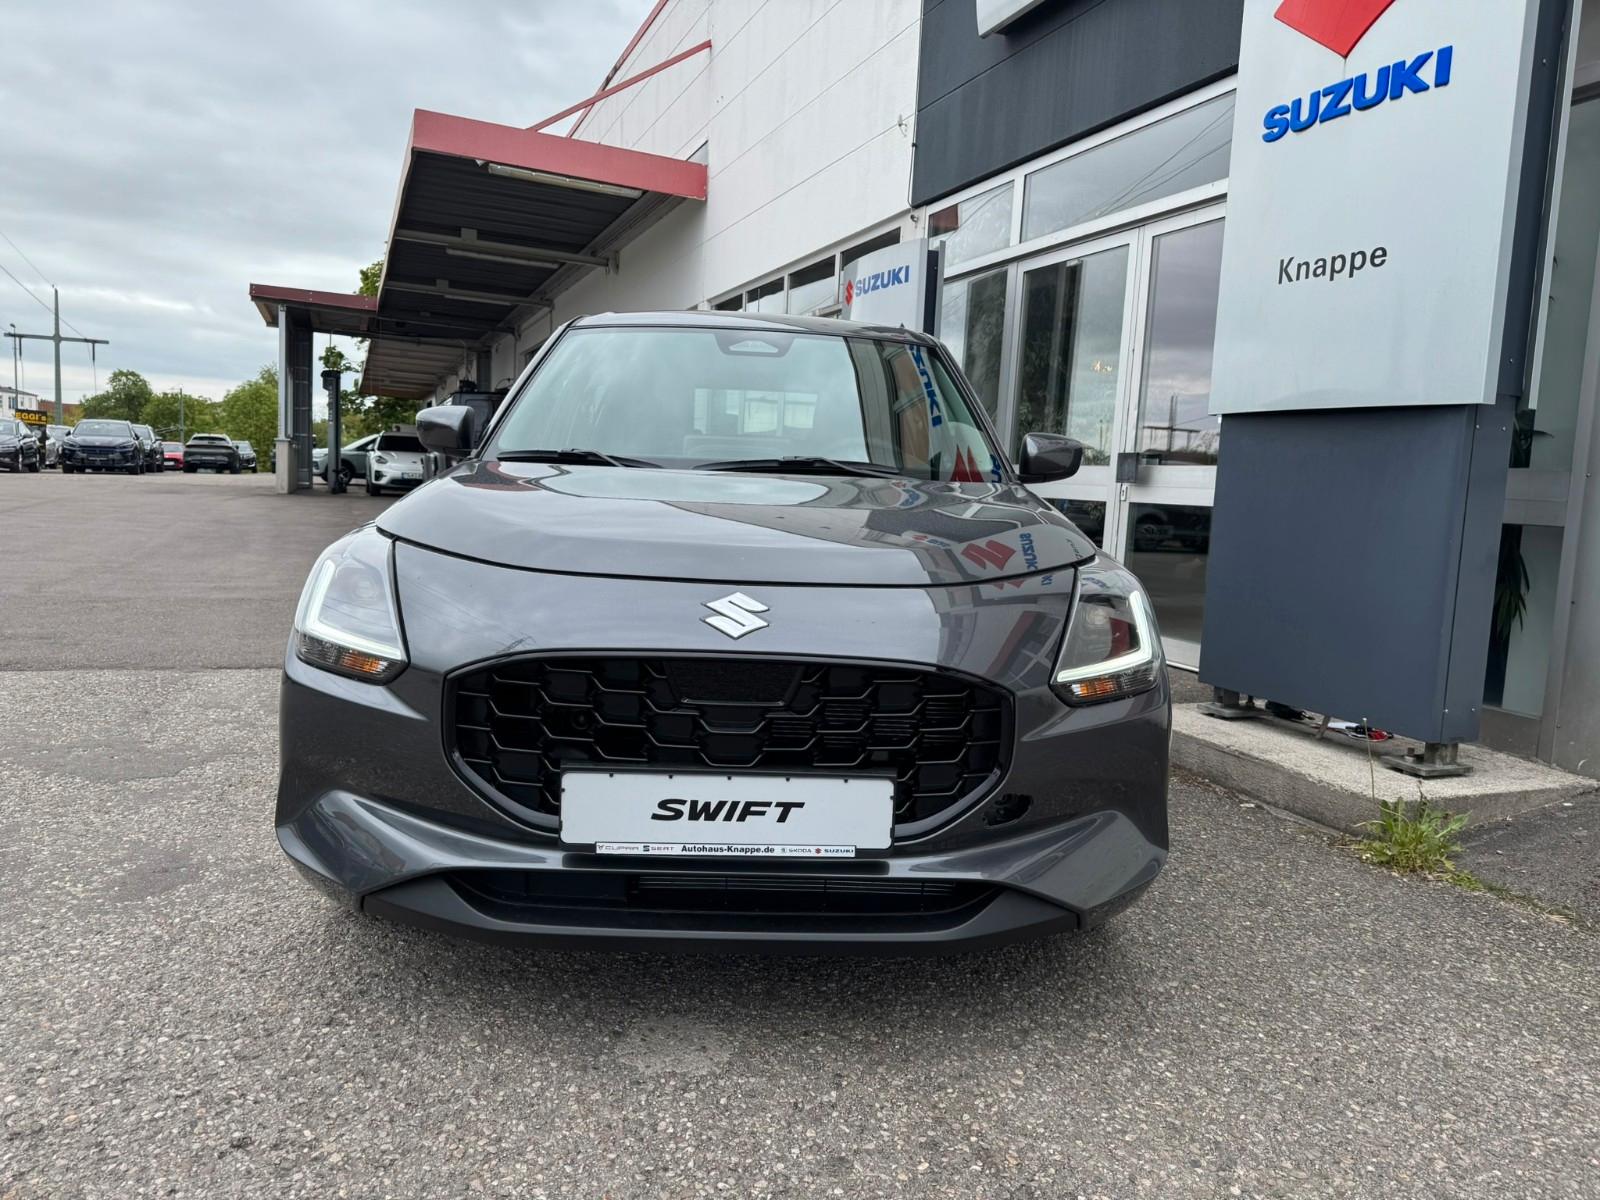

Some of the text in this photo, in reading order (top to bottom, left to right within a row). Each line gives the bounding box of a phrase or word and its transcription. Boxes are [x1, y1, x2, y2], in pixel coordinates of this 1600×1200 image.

[1262, 45, 1453, 143] SUZUKI
[855, 265, 910, 297] SUZUKI
[1277, 245, 1388, 285] Knappe
[651, 798, 805, 823] SWIFT
[681, 844, 775, 855] Autohaus-Knappe.de
